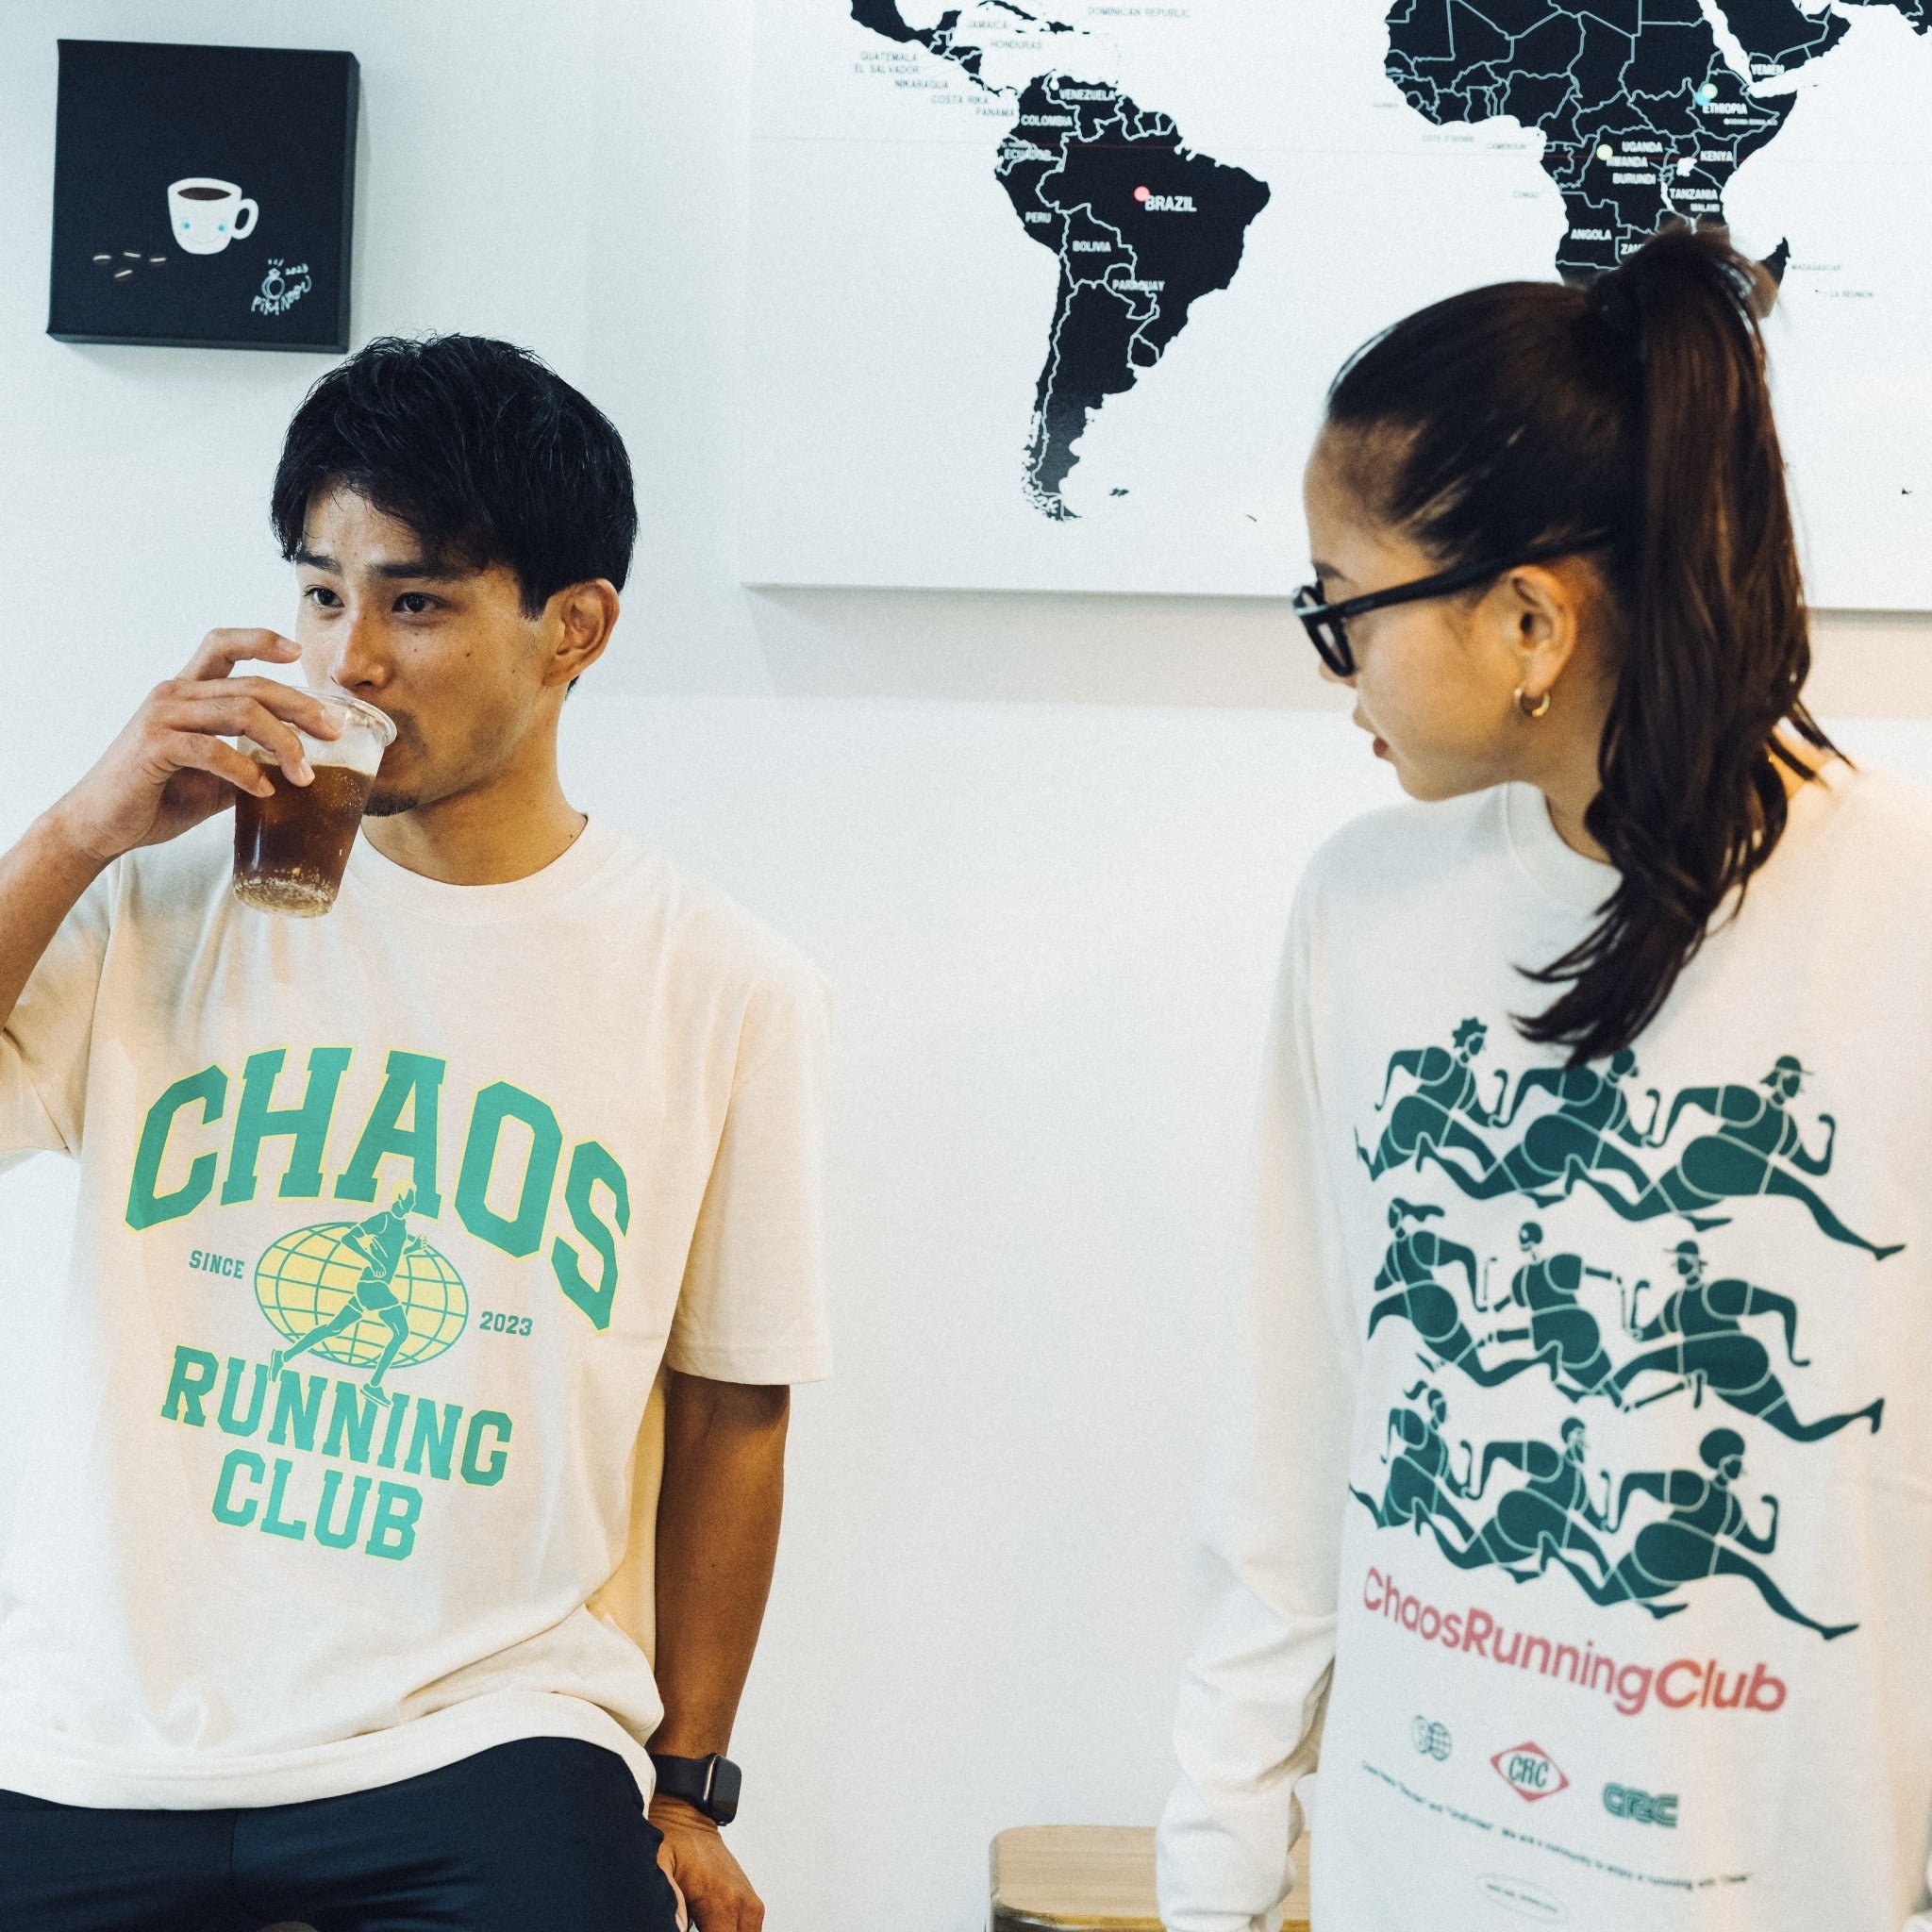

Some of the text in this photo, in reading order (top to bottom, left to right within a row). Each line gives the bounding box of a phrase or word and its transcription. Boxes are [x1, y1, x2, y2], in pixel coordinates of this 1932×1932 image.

[1750, 63, 1785, 75] YEMEN
[1059, 89, 1116, 101] VENEZUELA
[1702, 102, 1748, 114] ETHIOPIA
[1020, 114, 1074, 127] COLOMBIA
[1622, 141, 1664, 154] UGANDA
[1606, 156, 1649, 168] RWANDA
[1700, 150, 1734, 162] KENYA
[1612, 173, 1657, 185] BURUNDI
[1669, 188, 1720, 201] TANZANIA
[1144, 194, 1198, 213] BRAZIL
[1024, 211, 1052, 225] PERU
[1570, 228, 1613, 241] ANGOLA
[1072, 240, 1112, 253] BOLIVIA
[1111, 278, 1166, 291] PARAGUAY
[125, 1046, 631, 1332] CHAOS
[189, 1250, 245, 1279] SINCE
[479, 1311, 533, 1337] 2023
[160, 1343, 514, 1488] RUNNING
[210, 1447, 424, 1562] CLUB
[1363, 1566, 1788, 1715] ChaosRunningClub
[1509, 1754, 1548, 1789] CRC
